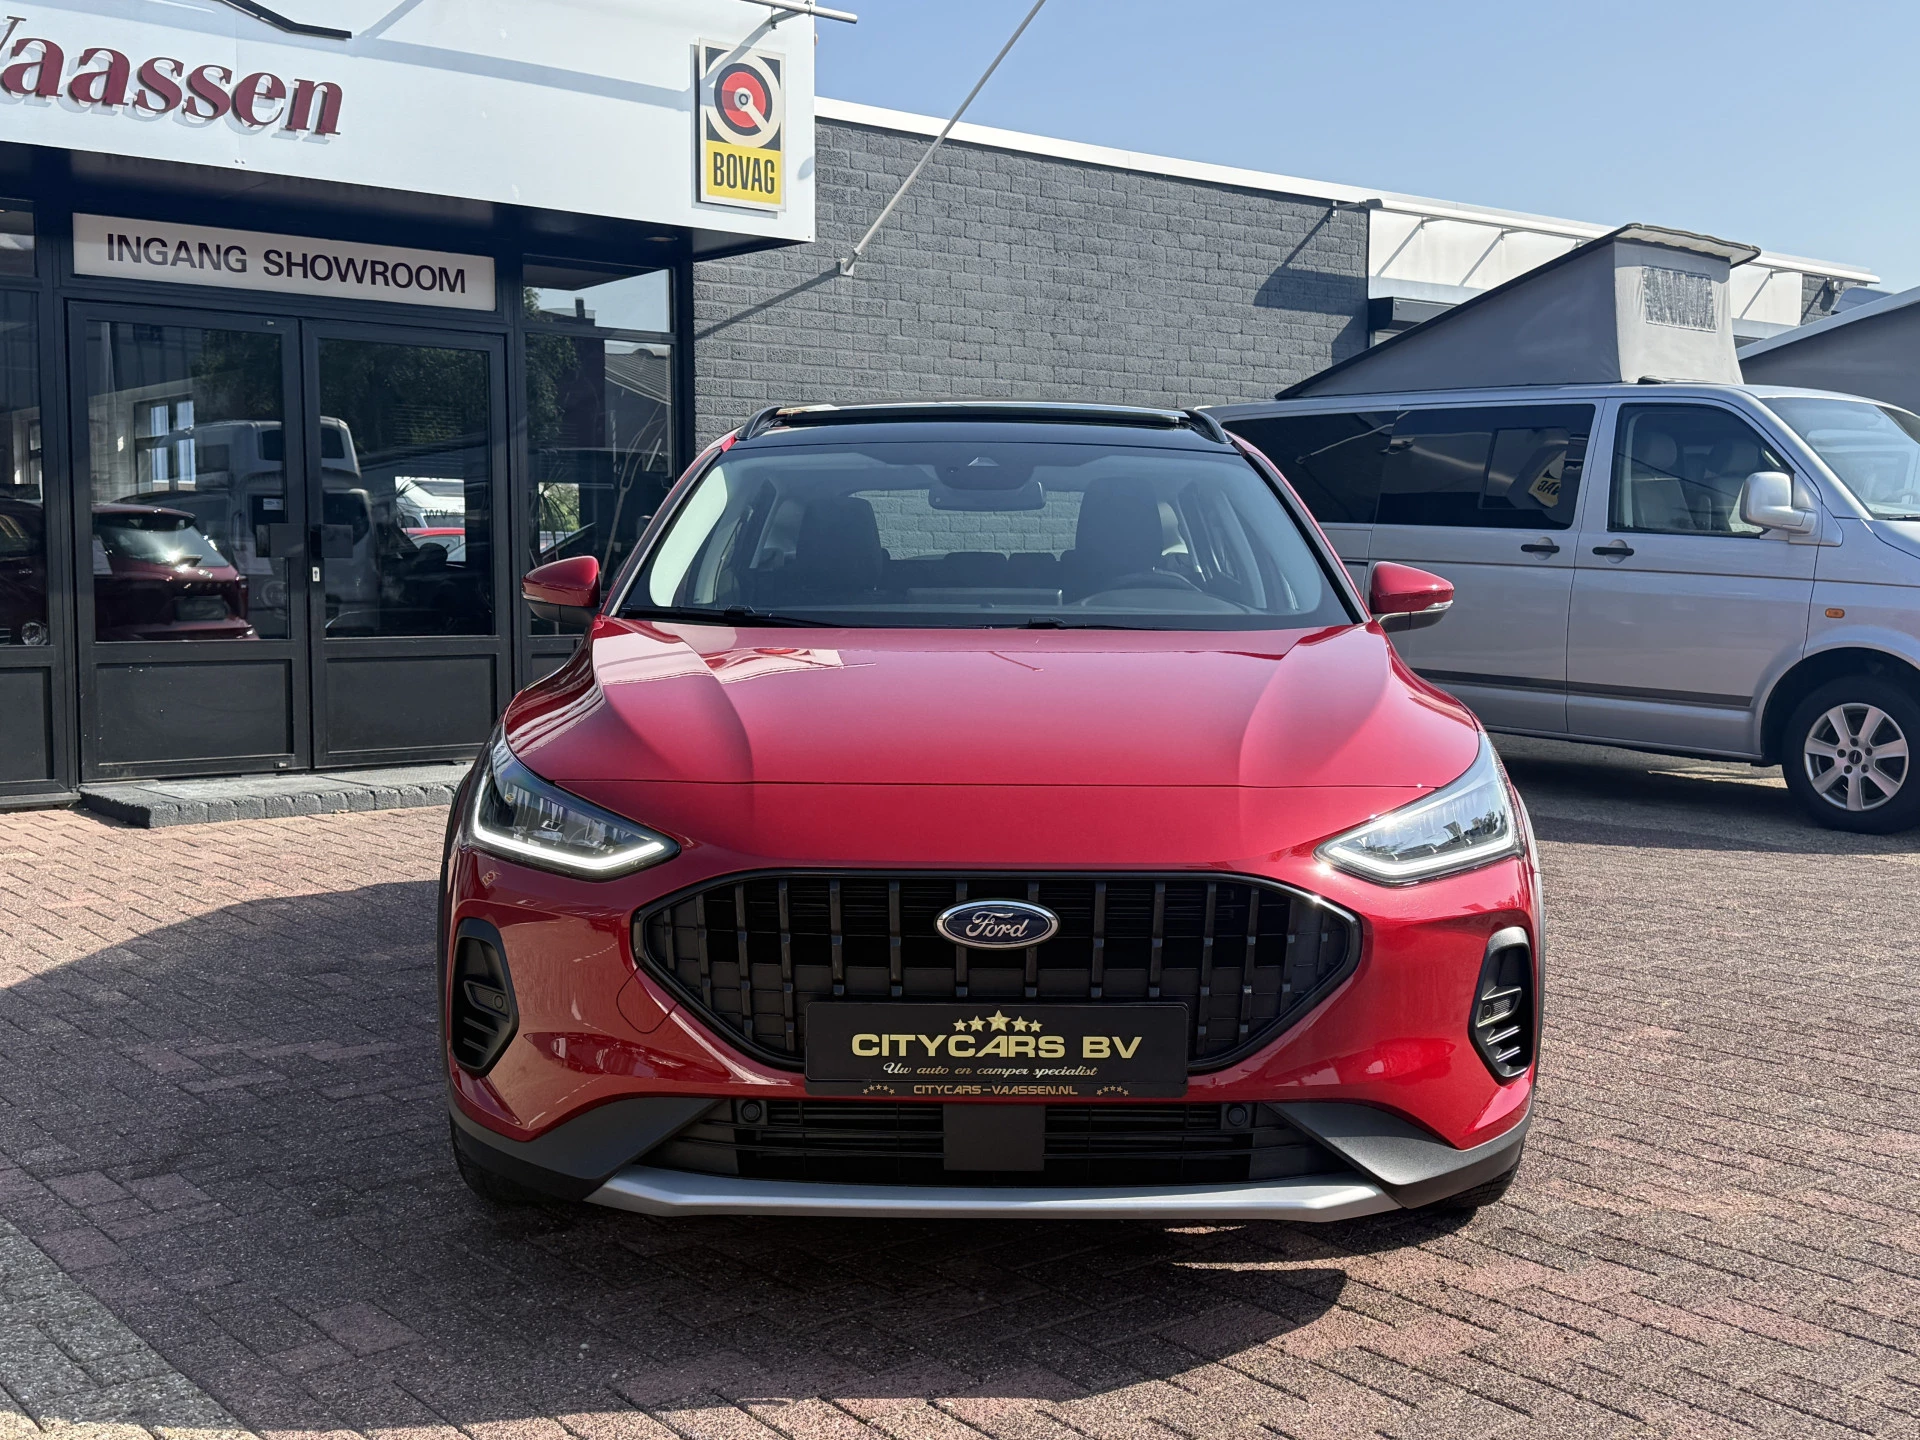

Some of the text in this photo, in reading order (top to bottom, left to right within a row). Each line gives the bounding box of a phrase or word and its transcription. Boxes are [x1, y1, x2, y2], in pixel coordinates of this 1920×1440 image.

[0, 15, 343, 135] aassen
[713, 151, 775, 195] BOVAG
[107, 233, 467, 294] INGANG SHOWROOM
[965, 911, 1030, 937] Ford
[851, 1033, 1143, 1059] CITYCARS BV
[883, 1062, 1098, 1079] Uw auto en camper specialist
[913, 1084, 1079, 1096] CITYCARS-VAASSEN.NL
